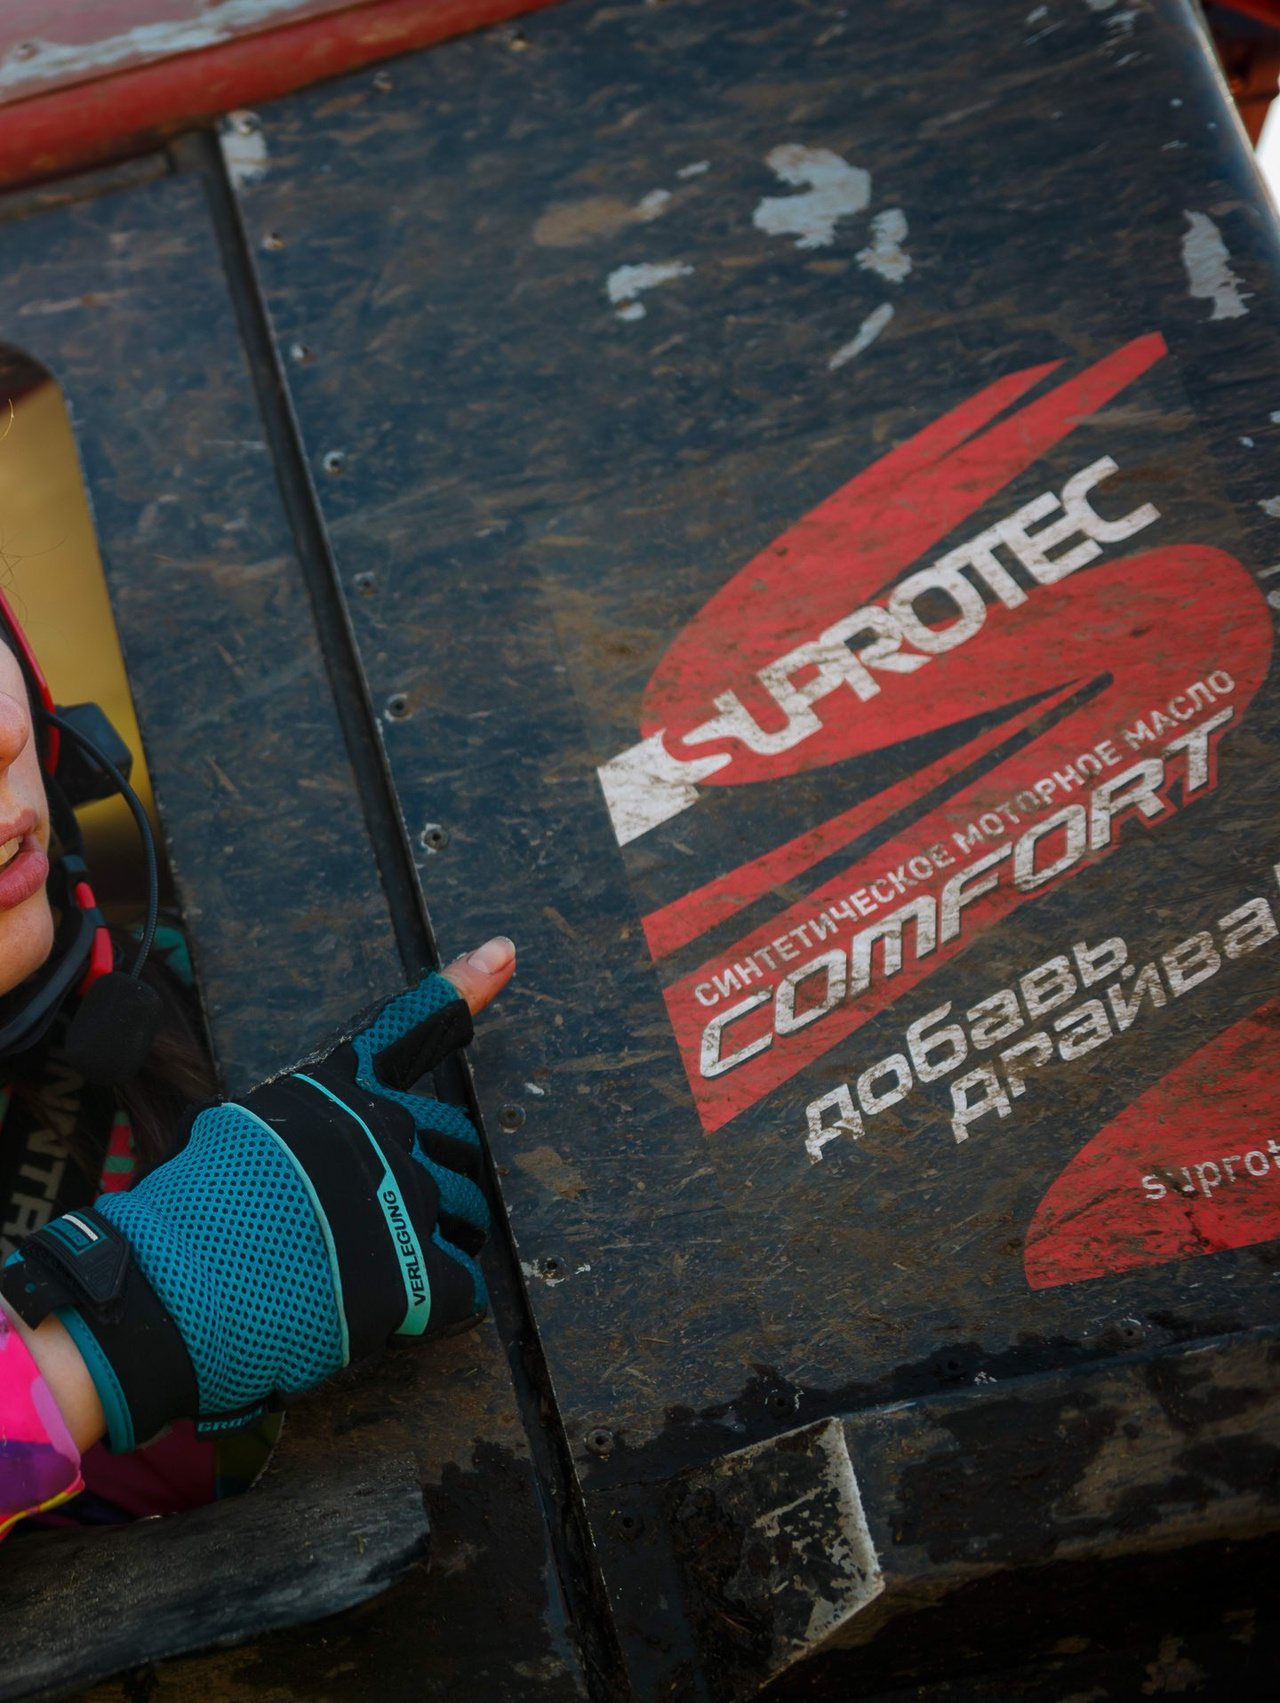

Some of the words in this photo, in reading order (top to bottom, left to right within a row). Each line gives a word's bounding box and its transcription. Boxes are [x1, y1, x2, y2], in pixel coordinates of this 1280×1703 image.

[598, 456, 1161, 846] SUPROTEC
[694, 841, 957, 1008] СИНТЕТИЧЕСКОЕ
[954, 740, 1120, 854] МОТОРНОЕ
[1120, 670, 1236, 754] МАСЛО
[699, 706, 1234, 1079] COMFORT
[382, 1189, 427, 1307] VERLEGUNG
